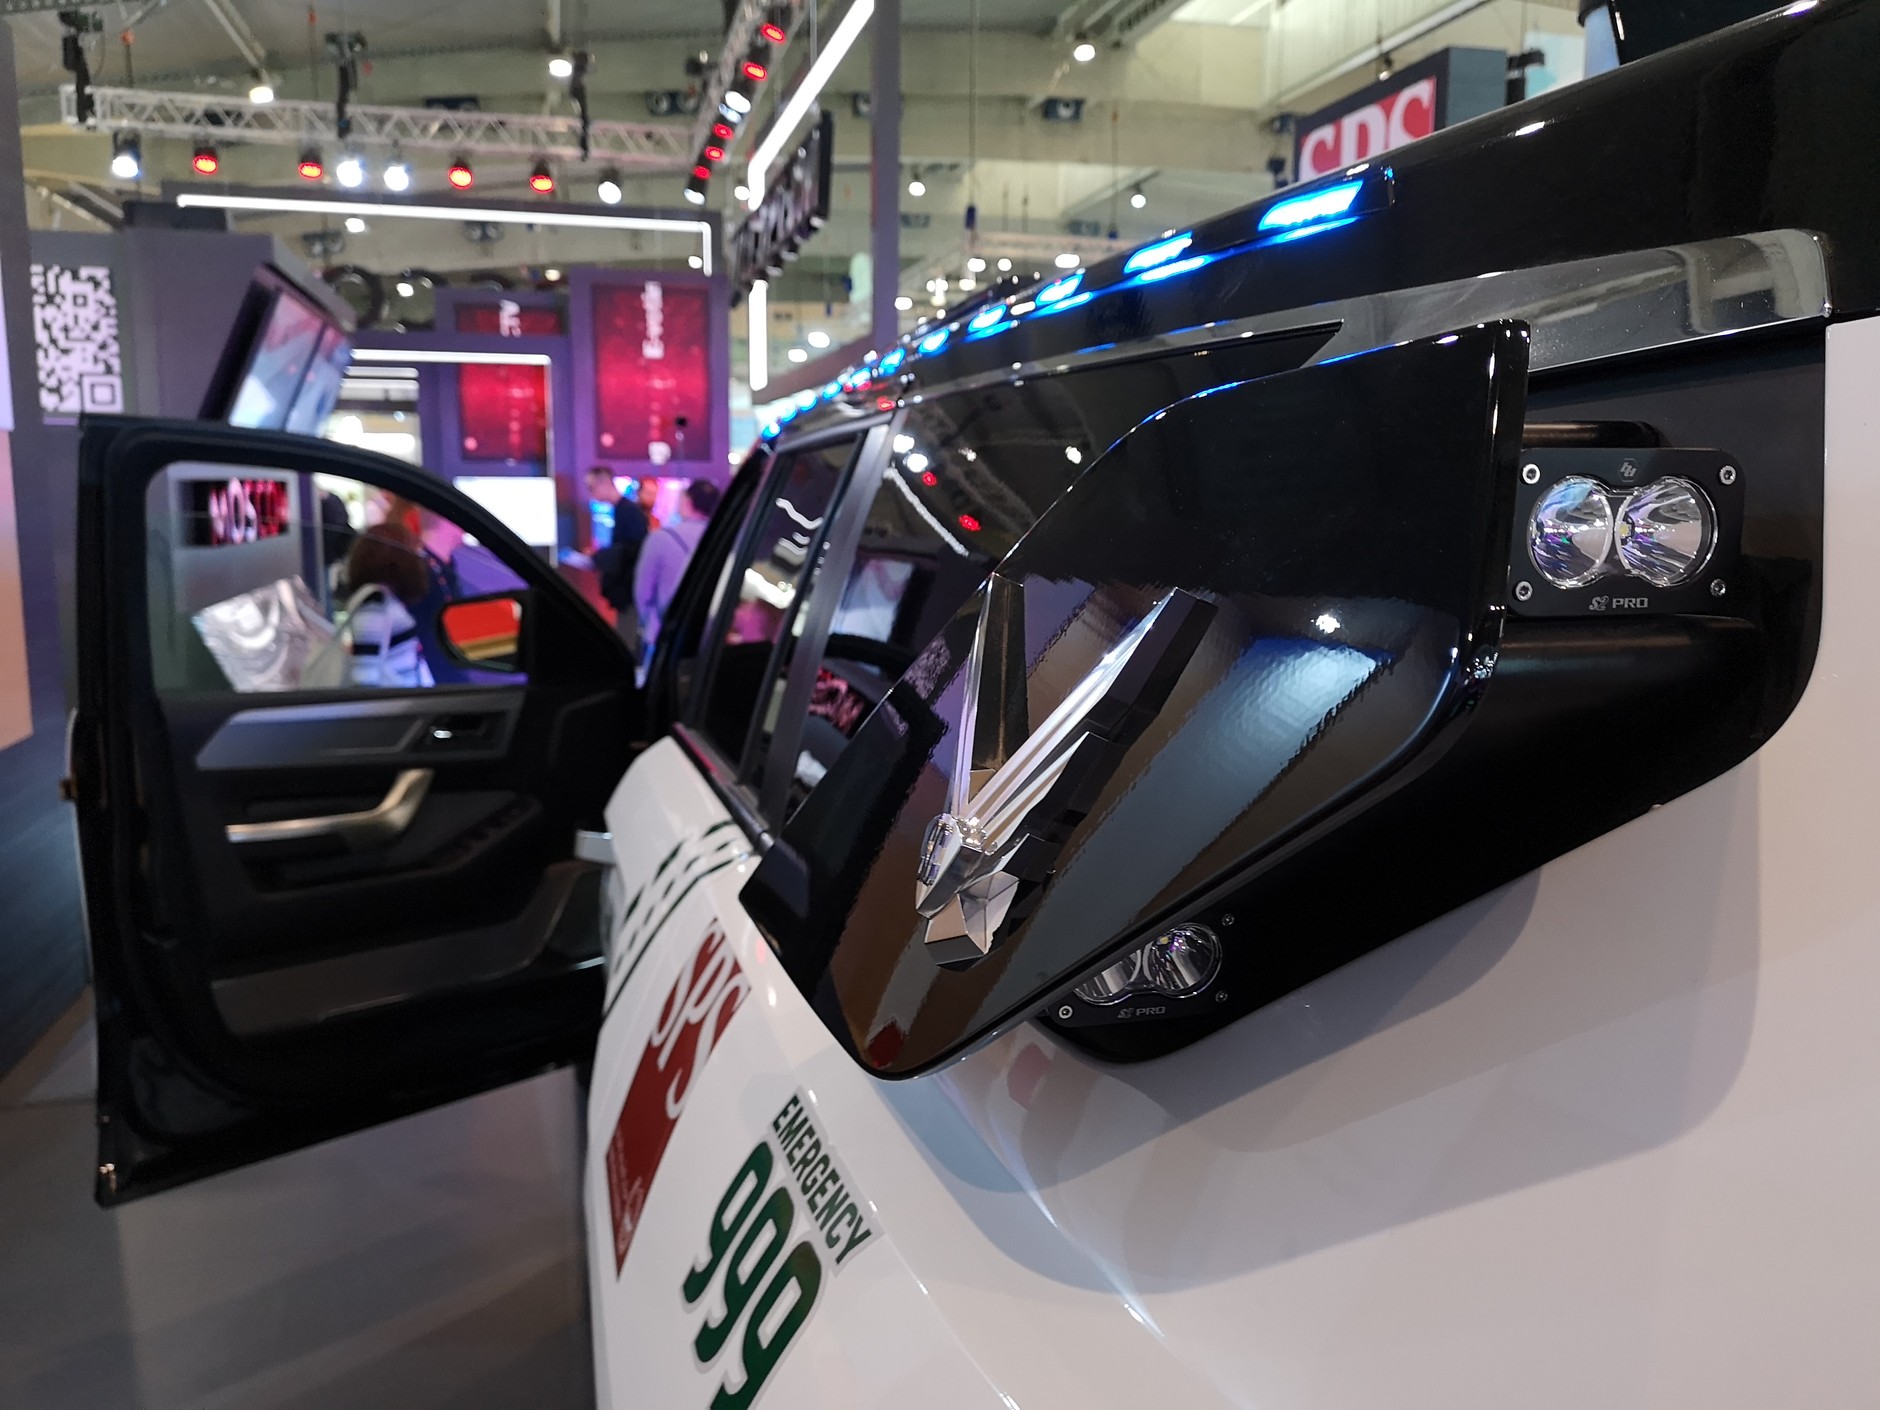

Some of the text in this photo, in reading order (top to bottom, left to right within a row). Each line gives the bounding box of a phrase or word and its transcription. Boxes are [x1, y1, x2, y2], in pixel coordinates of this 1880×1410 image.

[1612, 597, 1648, 609] PRO
[651, 922, 750, 1120] SPS
[1136, 1006, 1166, 1016] PRO
[773, 1094, 872, 1265] EMERGENCY
[683, 1141, 822, 1410] 999
